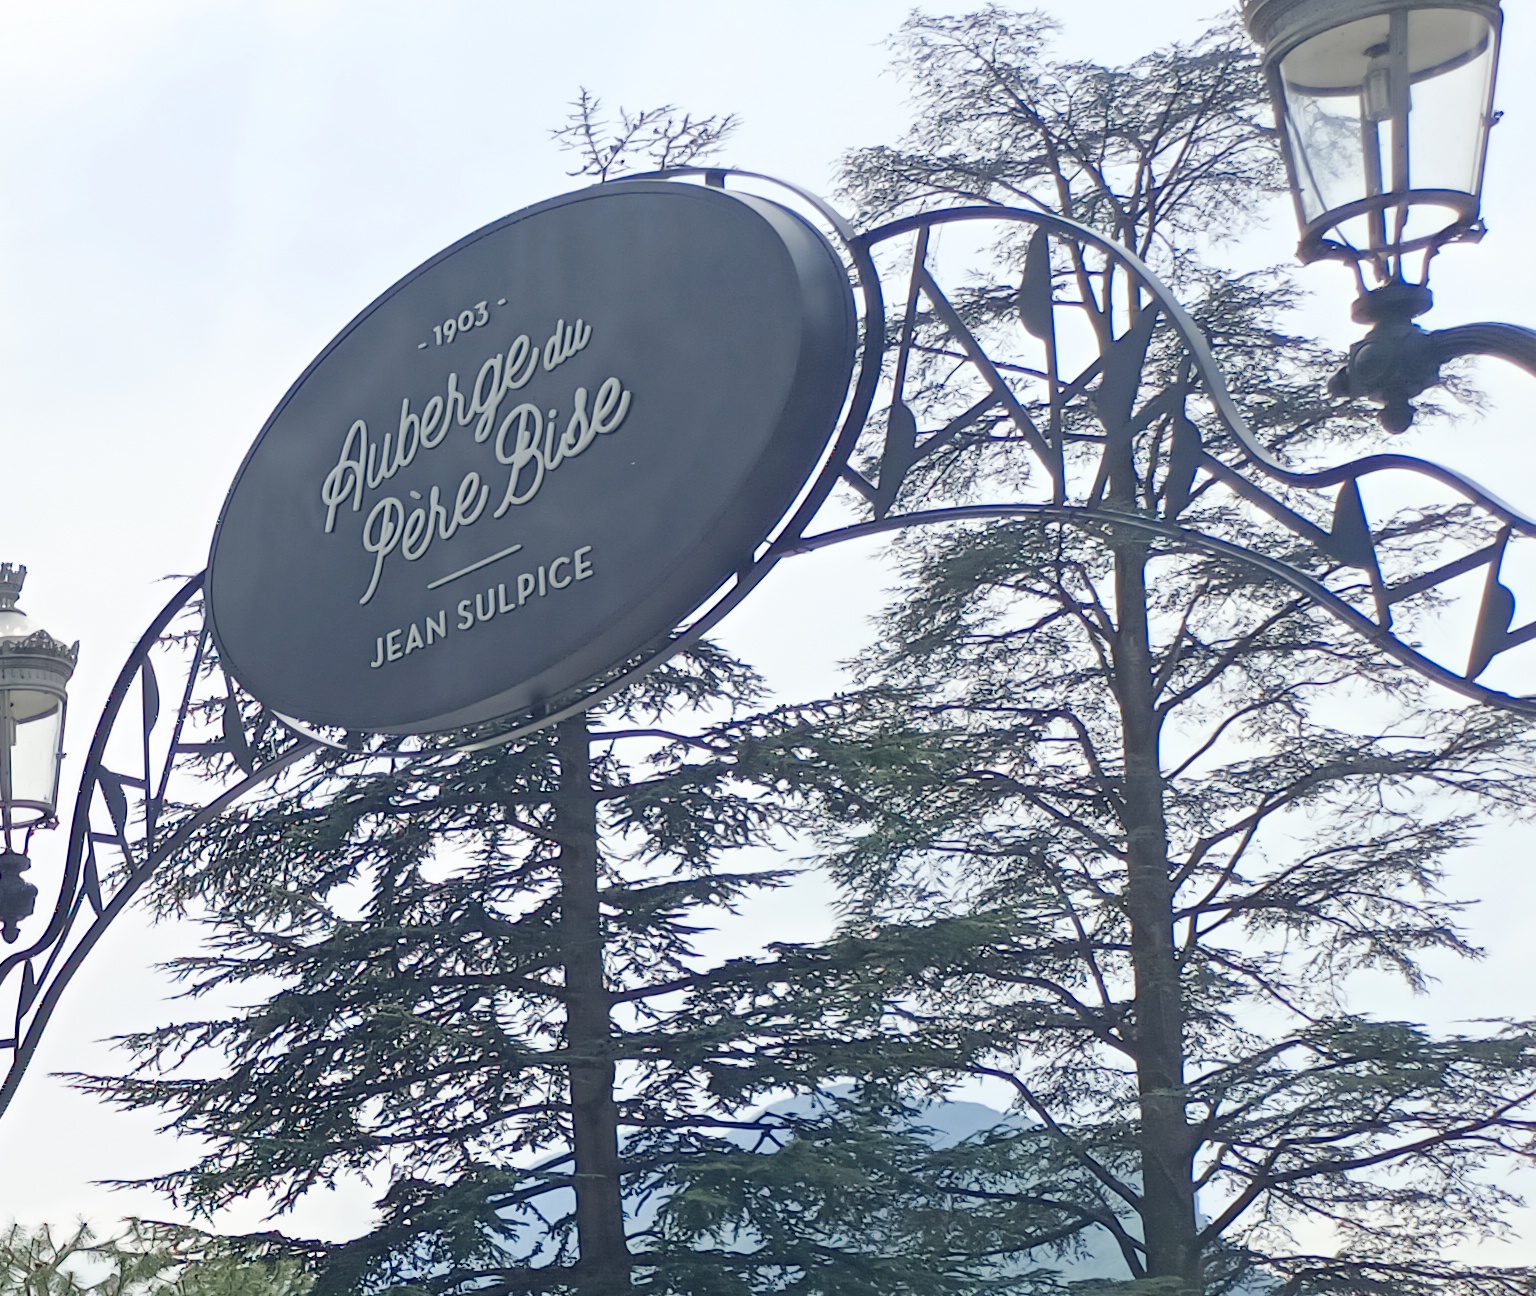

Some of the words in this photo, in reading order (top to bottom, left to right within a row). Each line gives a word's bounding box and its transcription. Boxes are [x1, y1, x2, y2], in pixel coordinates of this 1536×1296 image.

[321, 333, 540, 532] Auberge
[543, 318, 593, 371] du
[360, 471, 491, 605] Père
[493, 376, 632, 518] Bise
[369, 609, 449, 668] JEAN
[456, 545, 595, 631] SULPICE
